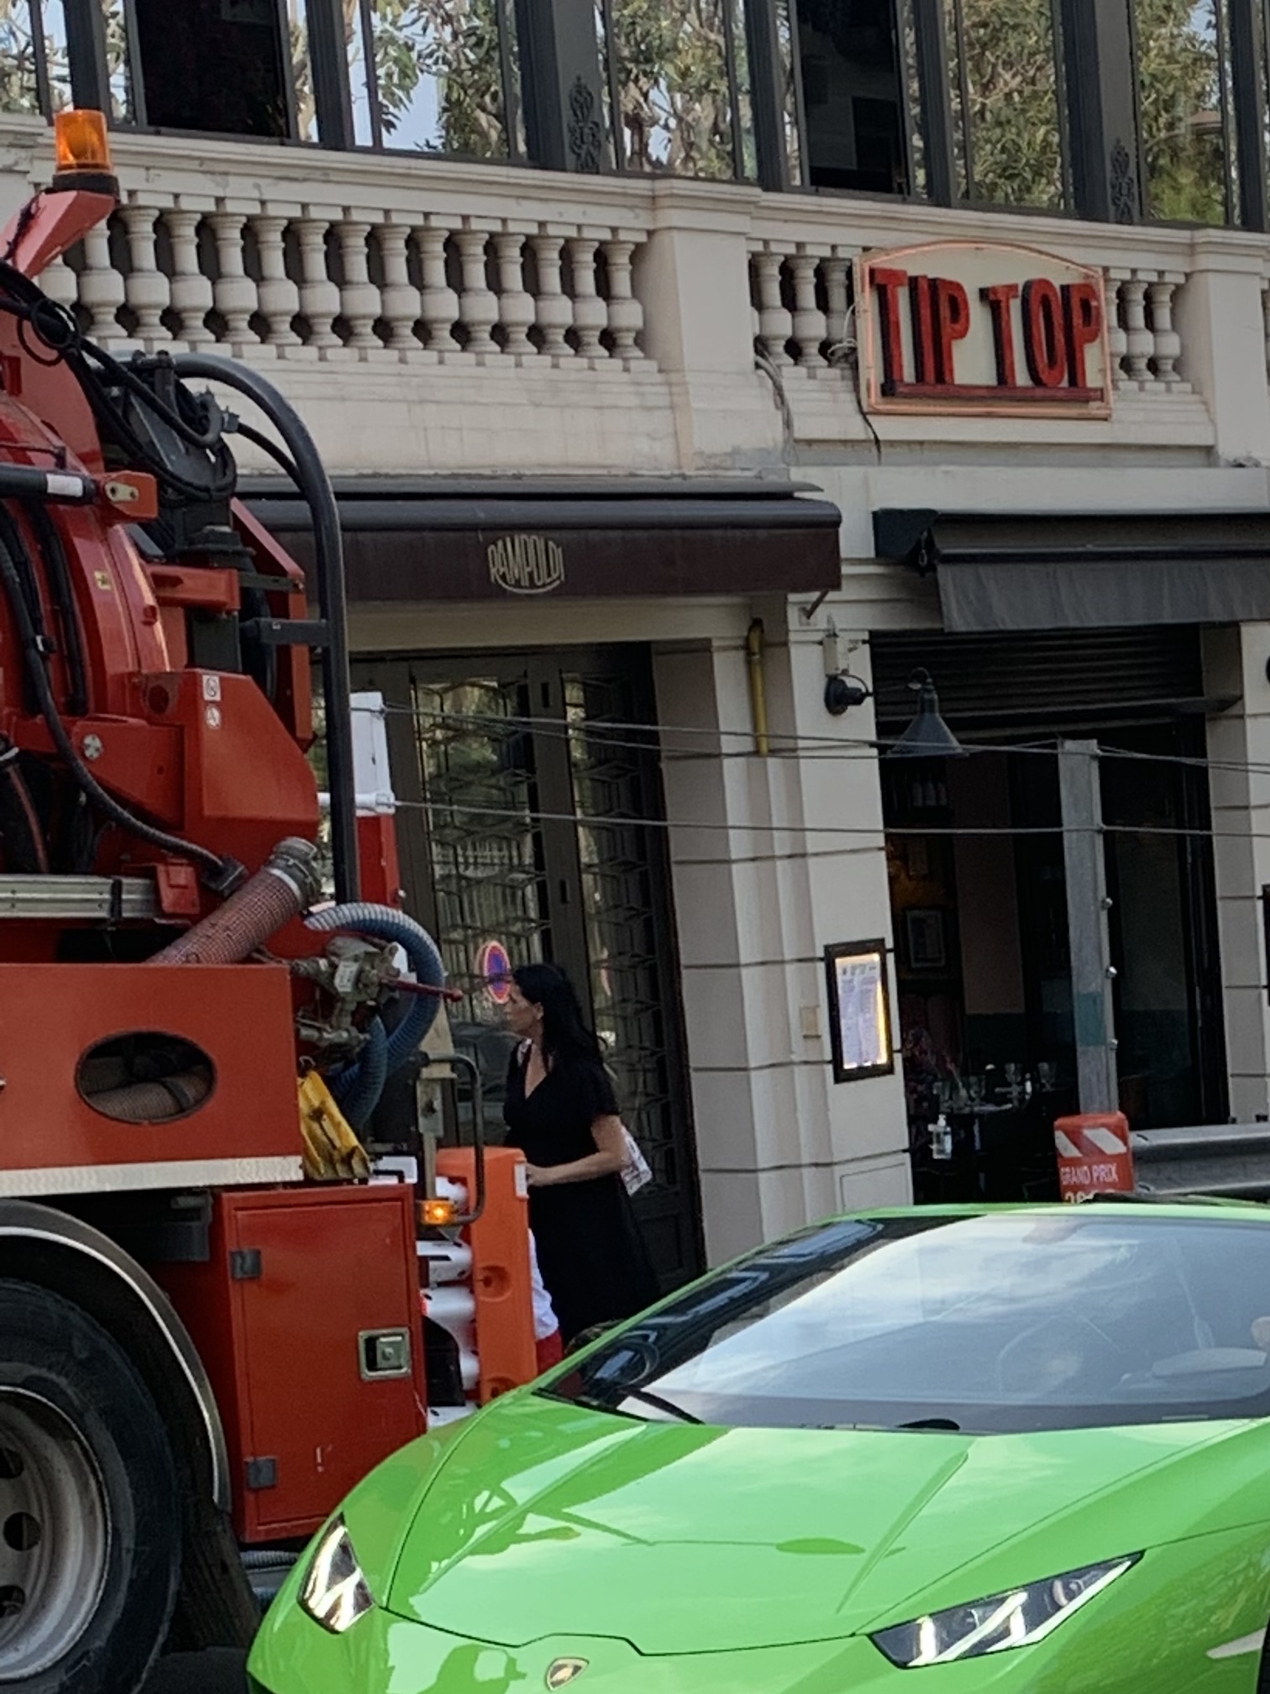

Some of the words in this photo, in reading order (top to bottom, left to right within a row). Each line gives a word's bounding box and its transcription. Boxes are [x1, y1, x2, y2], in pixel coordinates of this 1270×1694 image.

[870, 267, 970, 386] TIP
[979, 278, 1100, 388] TOP
[487, 534, 564, 594] RAMPOLDI
[1060, 1166, 1090, 1185] GRAND
[1092, 1163, 1119, 1183] PRIX
